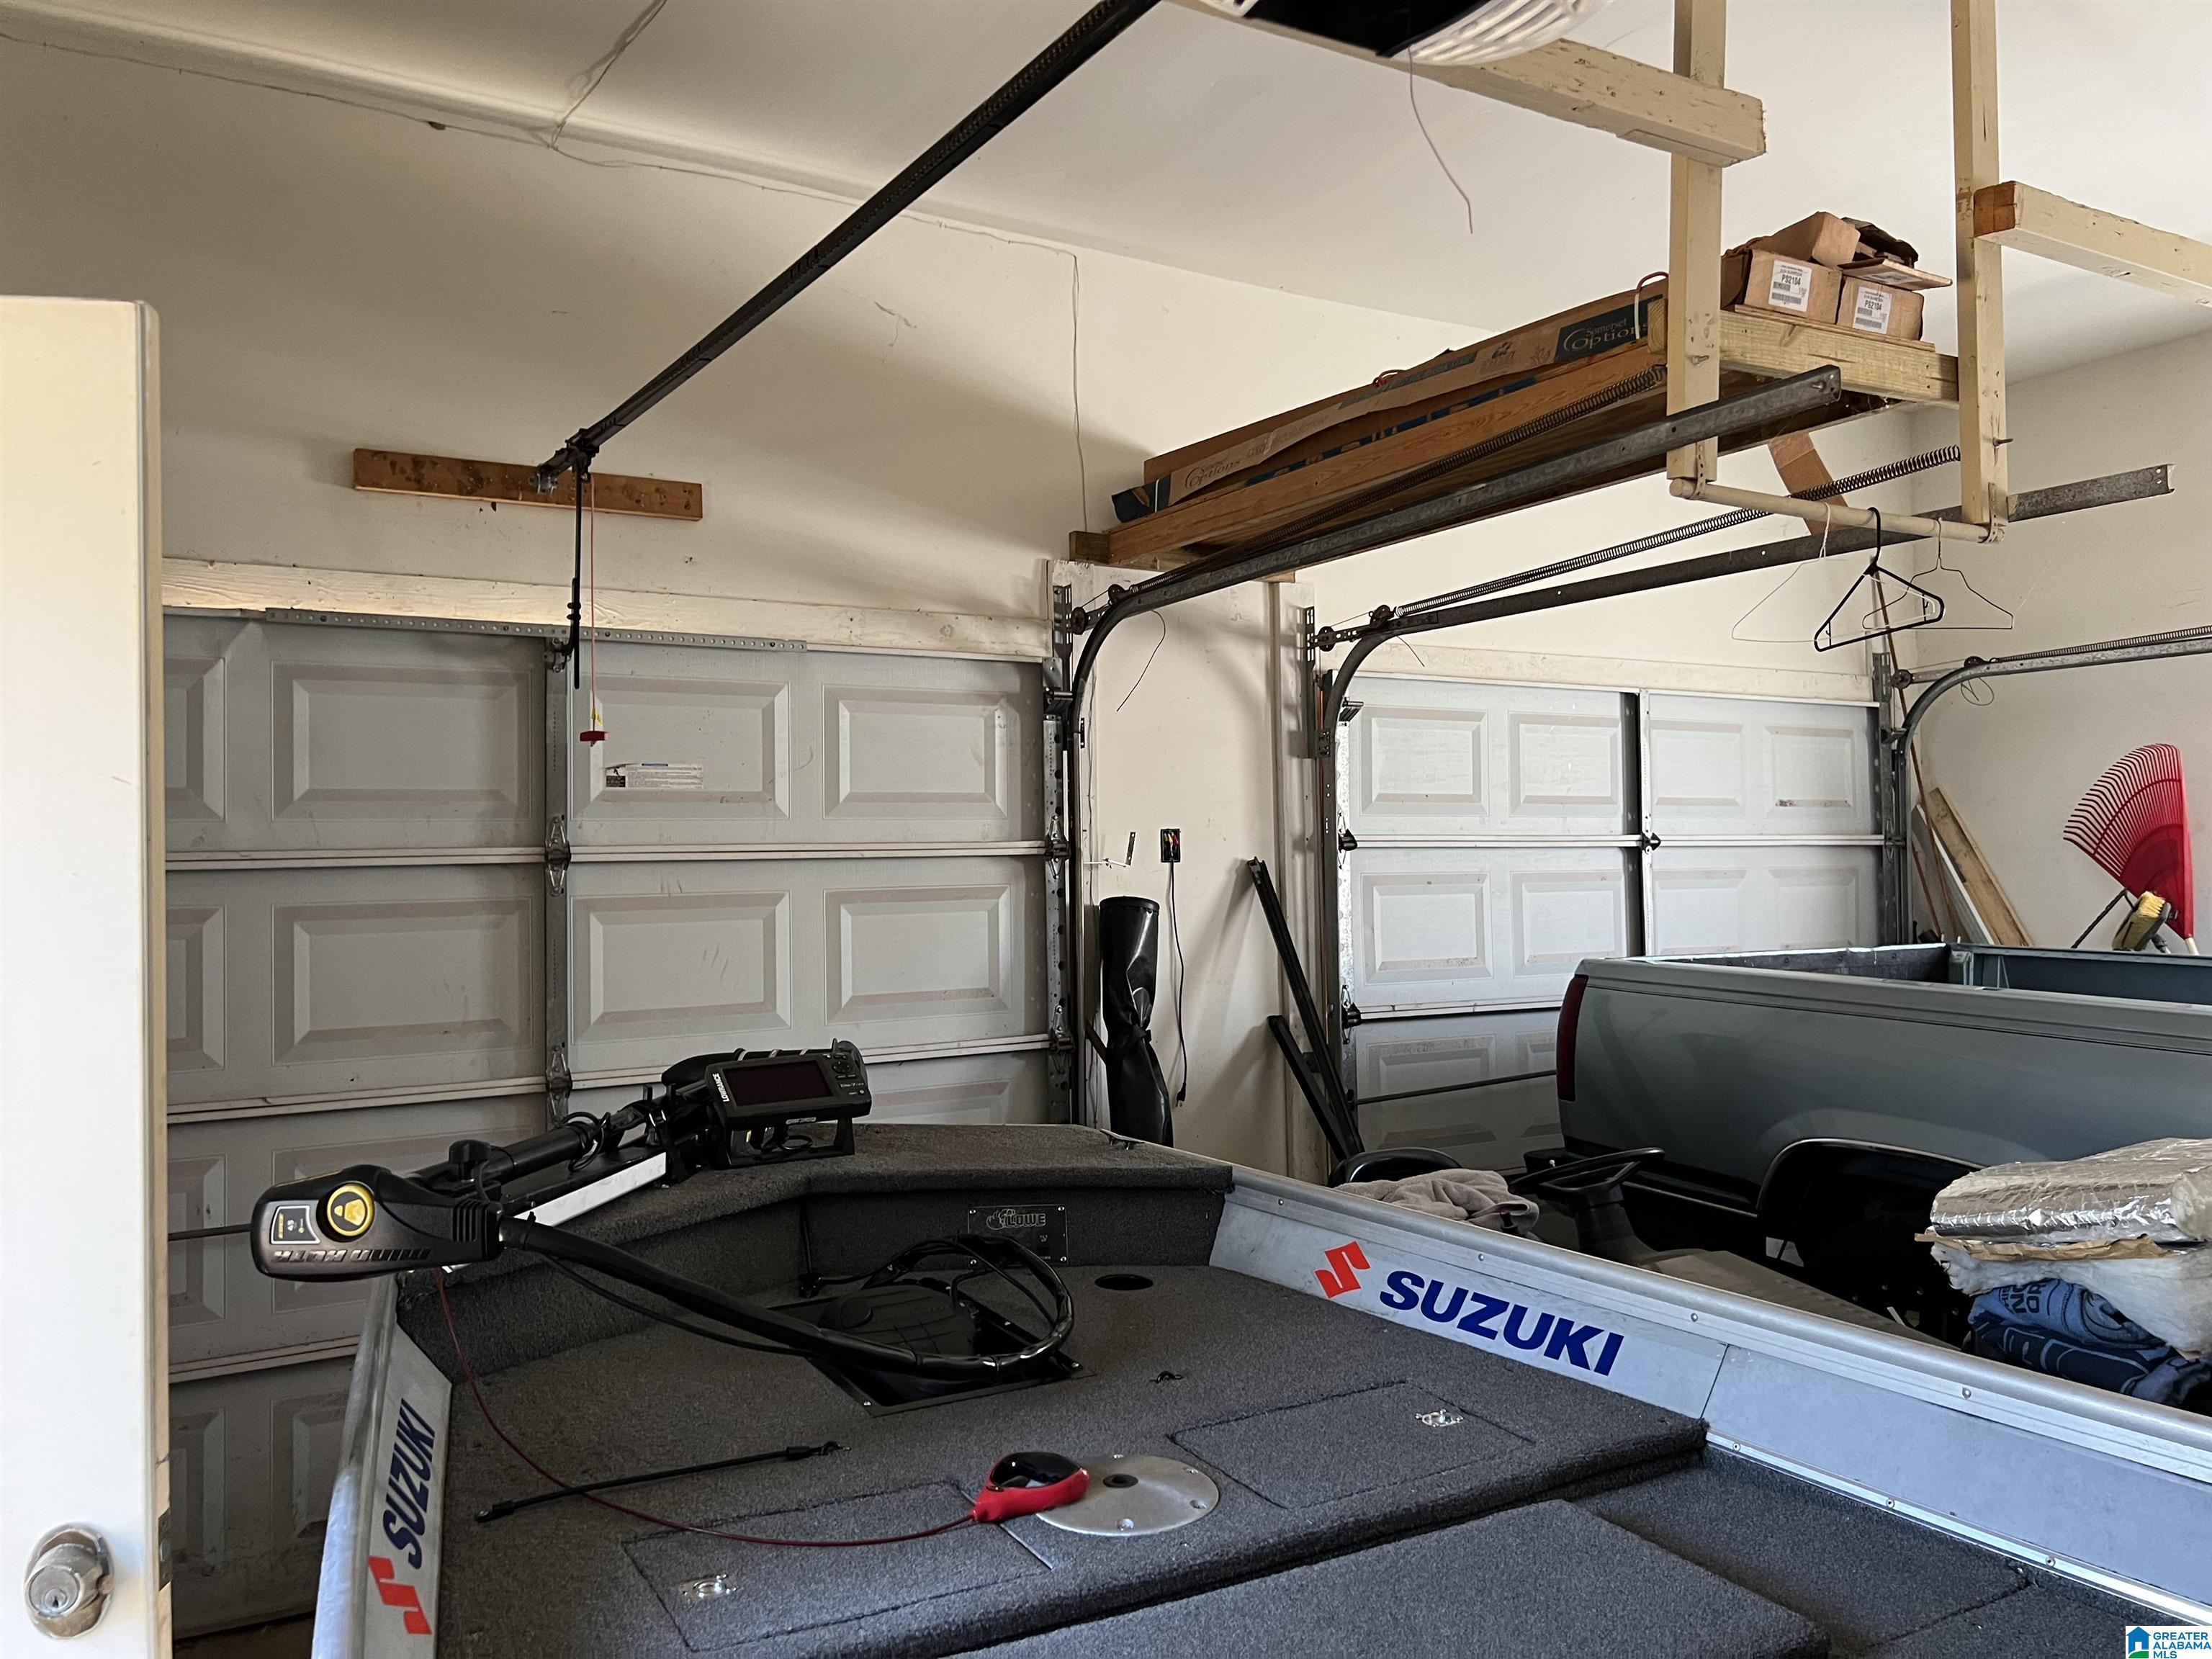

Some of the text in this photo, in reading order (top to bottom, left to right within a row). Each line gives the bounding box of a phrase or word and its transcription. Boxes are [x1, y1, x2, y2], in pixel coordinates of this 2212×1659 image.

[1586, 318, 1627, 336] Somerset
[1379, 1270, 1624, 1376] SUZUKI
[382, 1398, 435, 1570] SUZUKI
